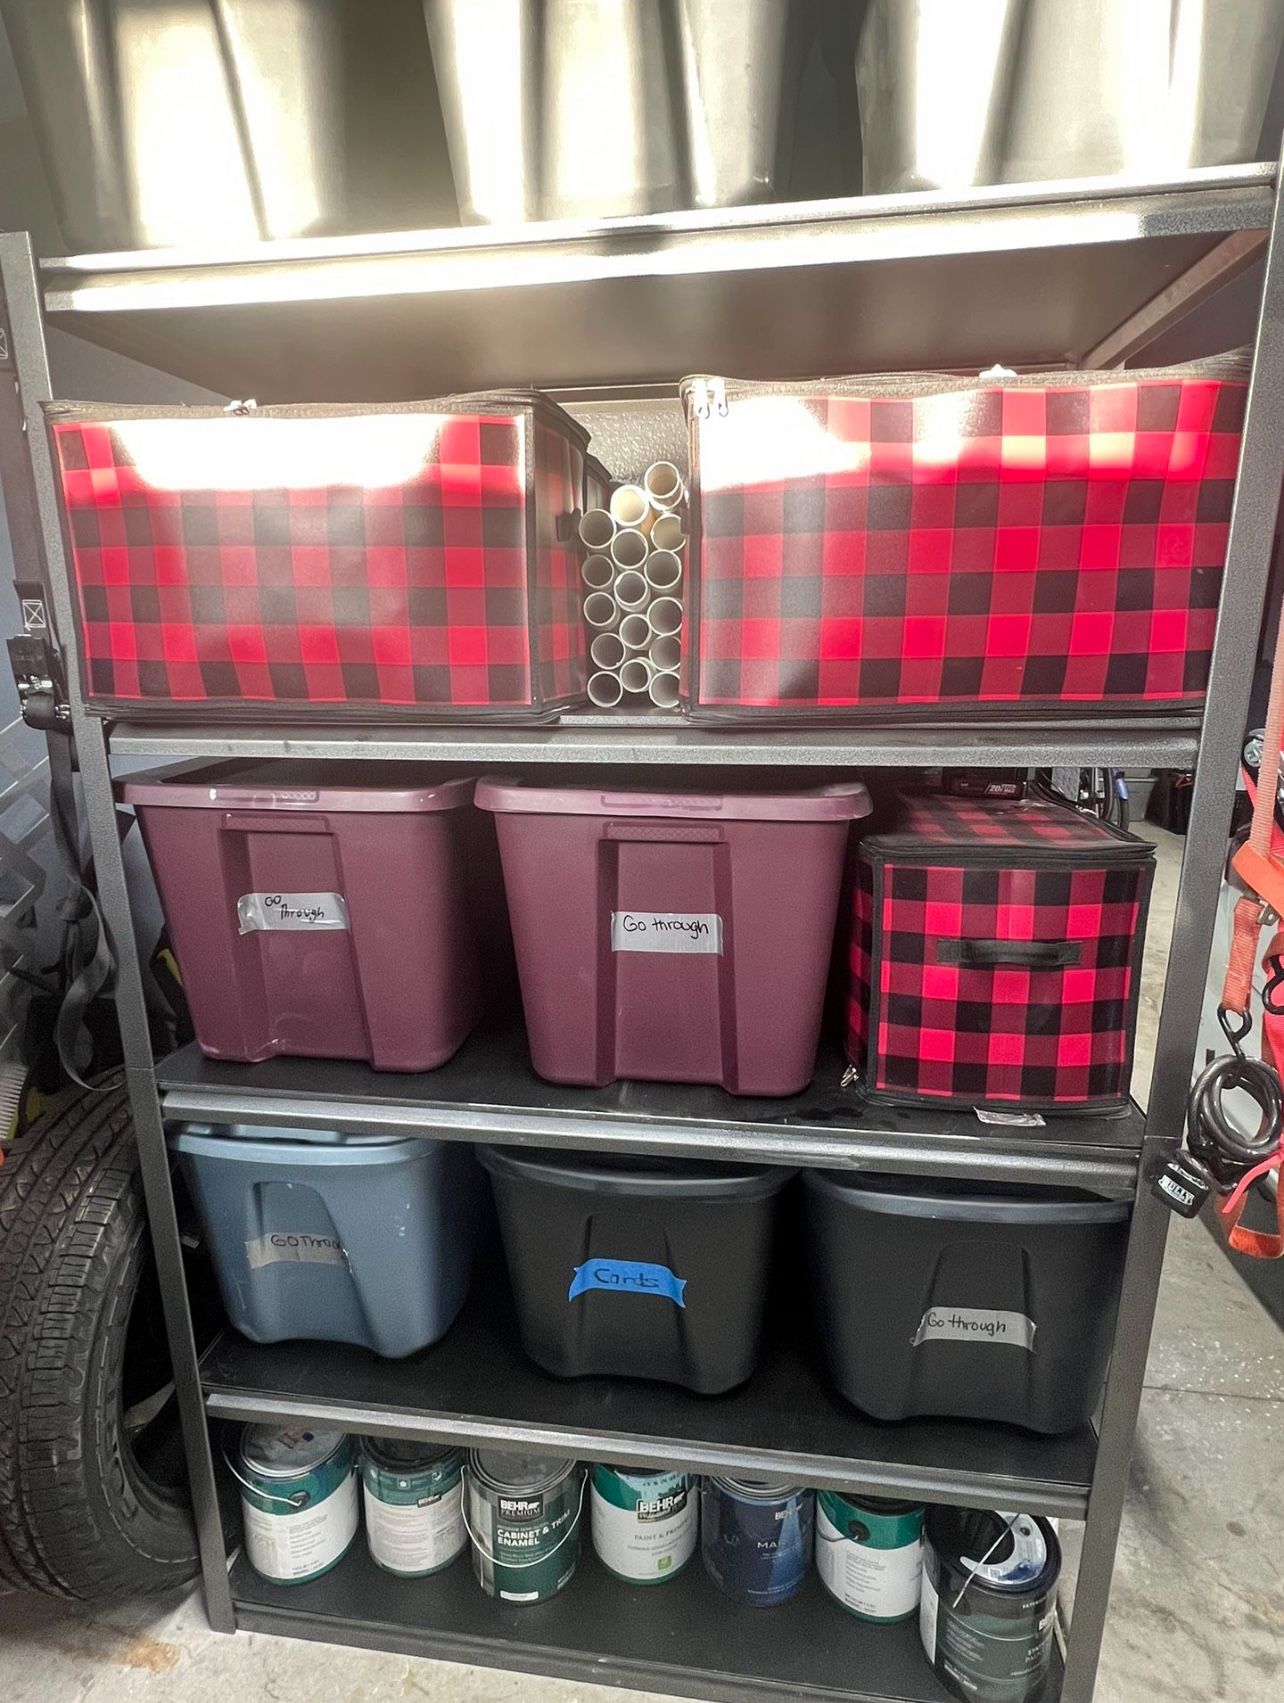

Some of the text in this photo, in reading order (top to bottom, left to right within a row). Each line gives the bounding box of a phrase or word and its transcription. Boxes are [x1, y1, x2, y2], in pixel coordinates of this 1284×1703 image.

[623, 915, 709, 939] Go through
[948, 1314, 1006, 1337] through
[500, 1500, 528, 1511] BEHR
[501, 1508, 541, 1516] PREMIUM
[639, 1496, 674, 1513] BEHR
[497, 1528, 541, 1539] CABINET
[542, 1526, 550, 1534] &
[551, 1509, 571, 1529] TRIM
[497, 1537, 541, 1547] ENAMEL
